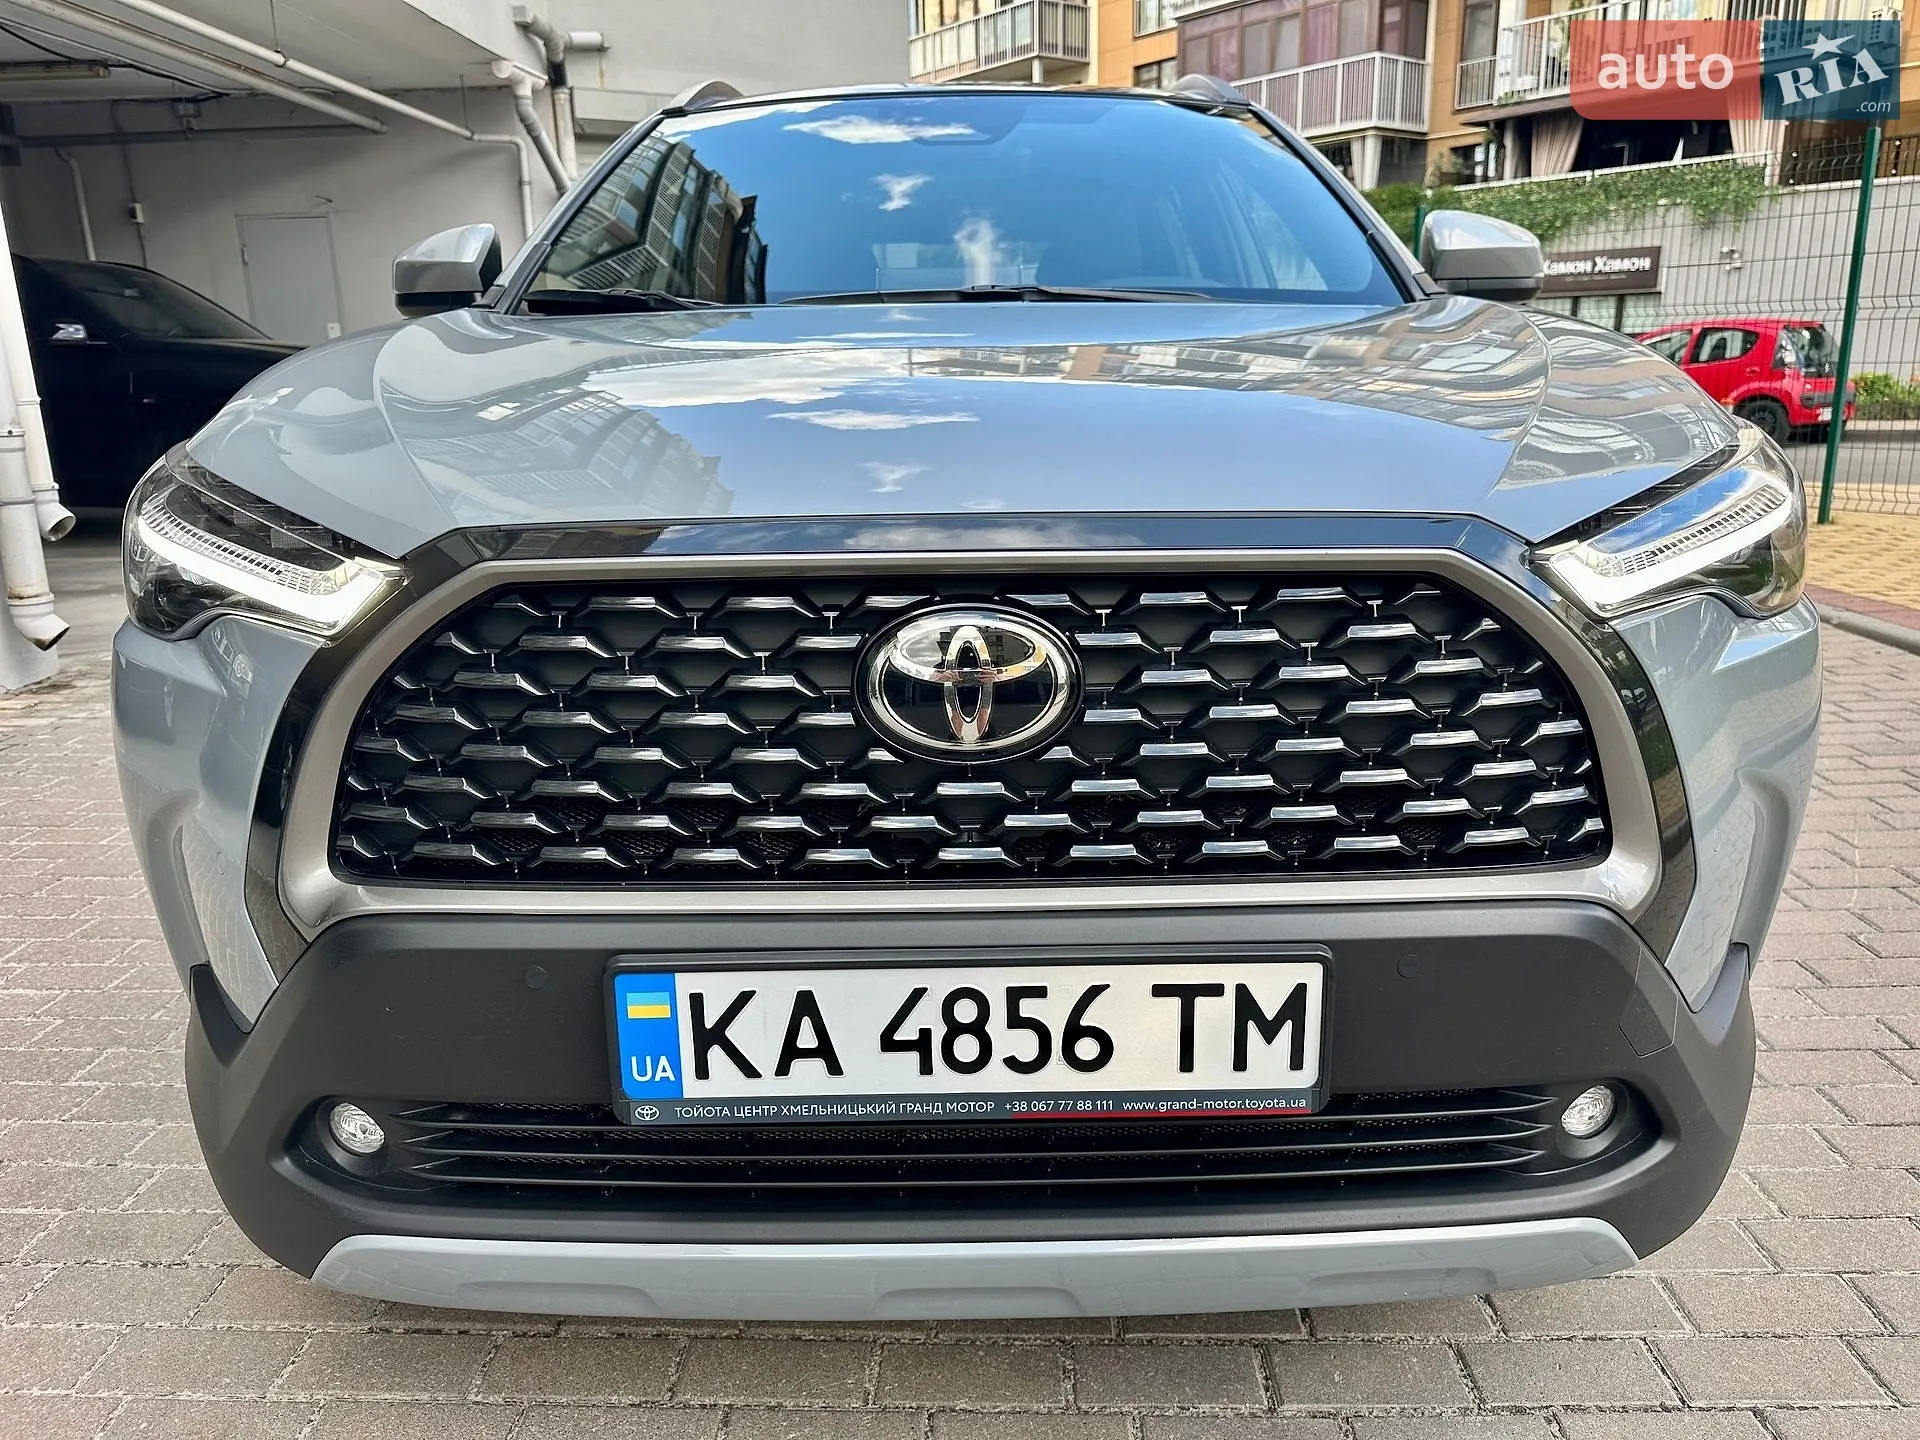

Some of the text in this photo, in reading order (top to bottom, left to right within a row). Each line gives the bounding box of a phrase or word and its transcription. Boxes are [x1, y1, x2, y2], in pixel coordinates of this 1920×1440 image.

[688, 982, 1308, 1080] KA 4856 TM
[630, 1055, 676, 1082] UA
[674, 1105, 731, 1118] ТОЙОТА
[734, 1105, 778, 1119] ЦЕНТР
[781, 1101, 896, 1117] ХМЕЛЬНИЦЬКИЙ
[899, 1102, 943, 1115] ГРАНД
[946, 1101, 995, 1114] МОТОР
[1122, 1098, 1306, 1112] www.grand-motor.toyota.ua
